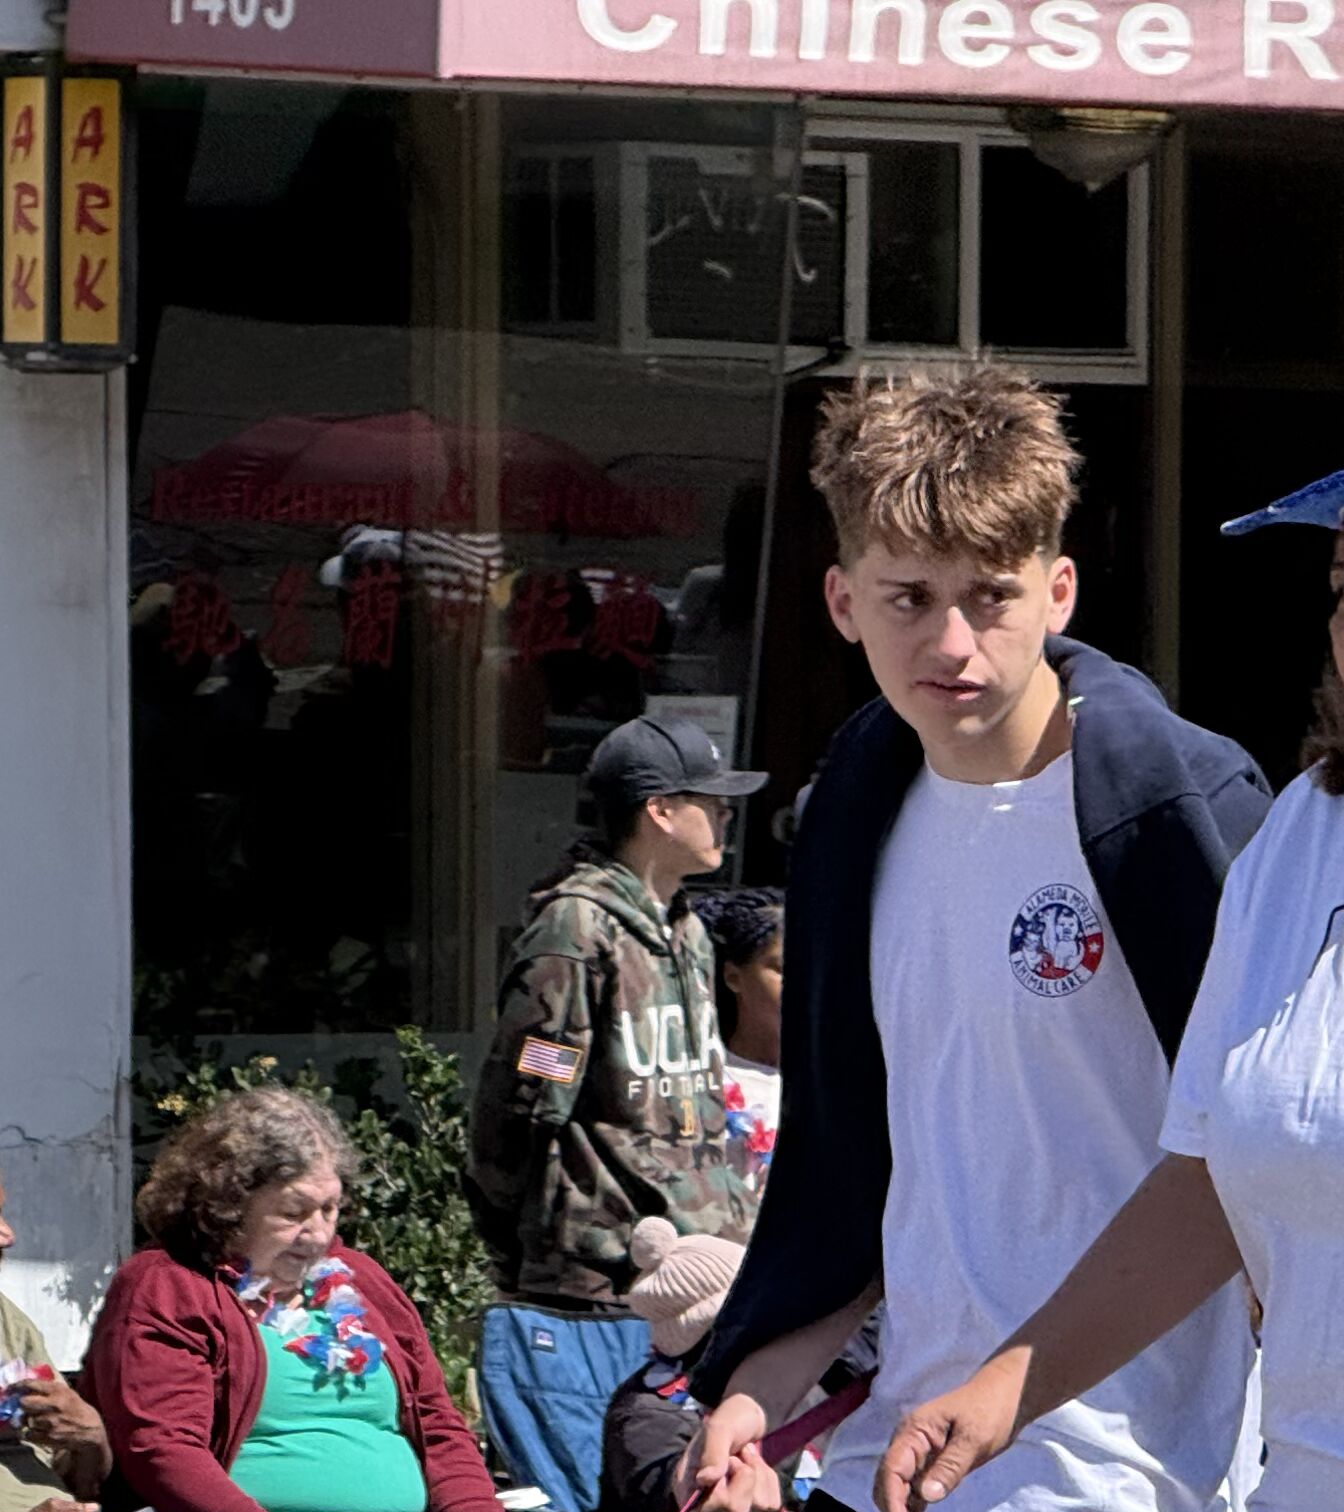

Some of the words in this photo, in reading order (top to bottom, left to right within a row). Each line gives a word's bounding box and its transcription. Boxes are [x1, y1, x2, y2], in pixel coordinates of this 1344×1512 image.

[577, 0, 1193, 76] Chinese
[9, 104, 40, 314] ARK
[70, 105, 111, 314] ARK
[1026, 886, 1068, 914] ALAMEDA
[1071, 893, 1097, 930] MOBILE
[1014, 959, 1052, 994] ANIMAL
[1054, 972, 1086, 994] CARE
[621, 1001, 726, 1077] UCA
